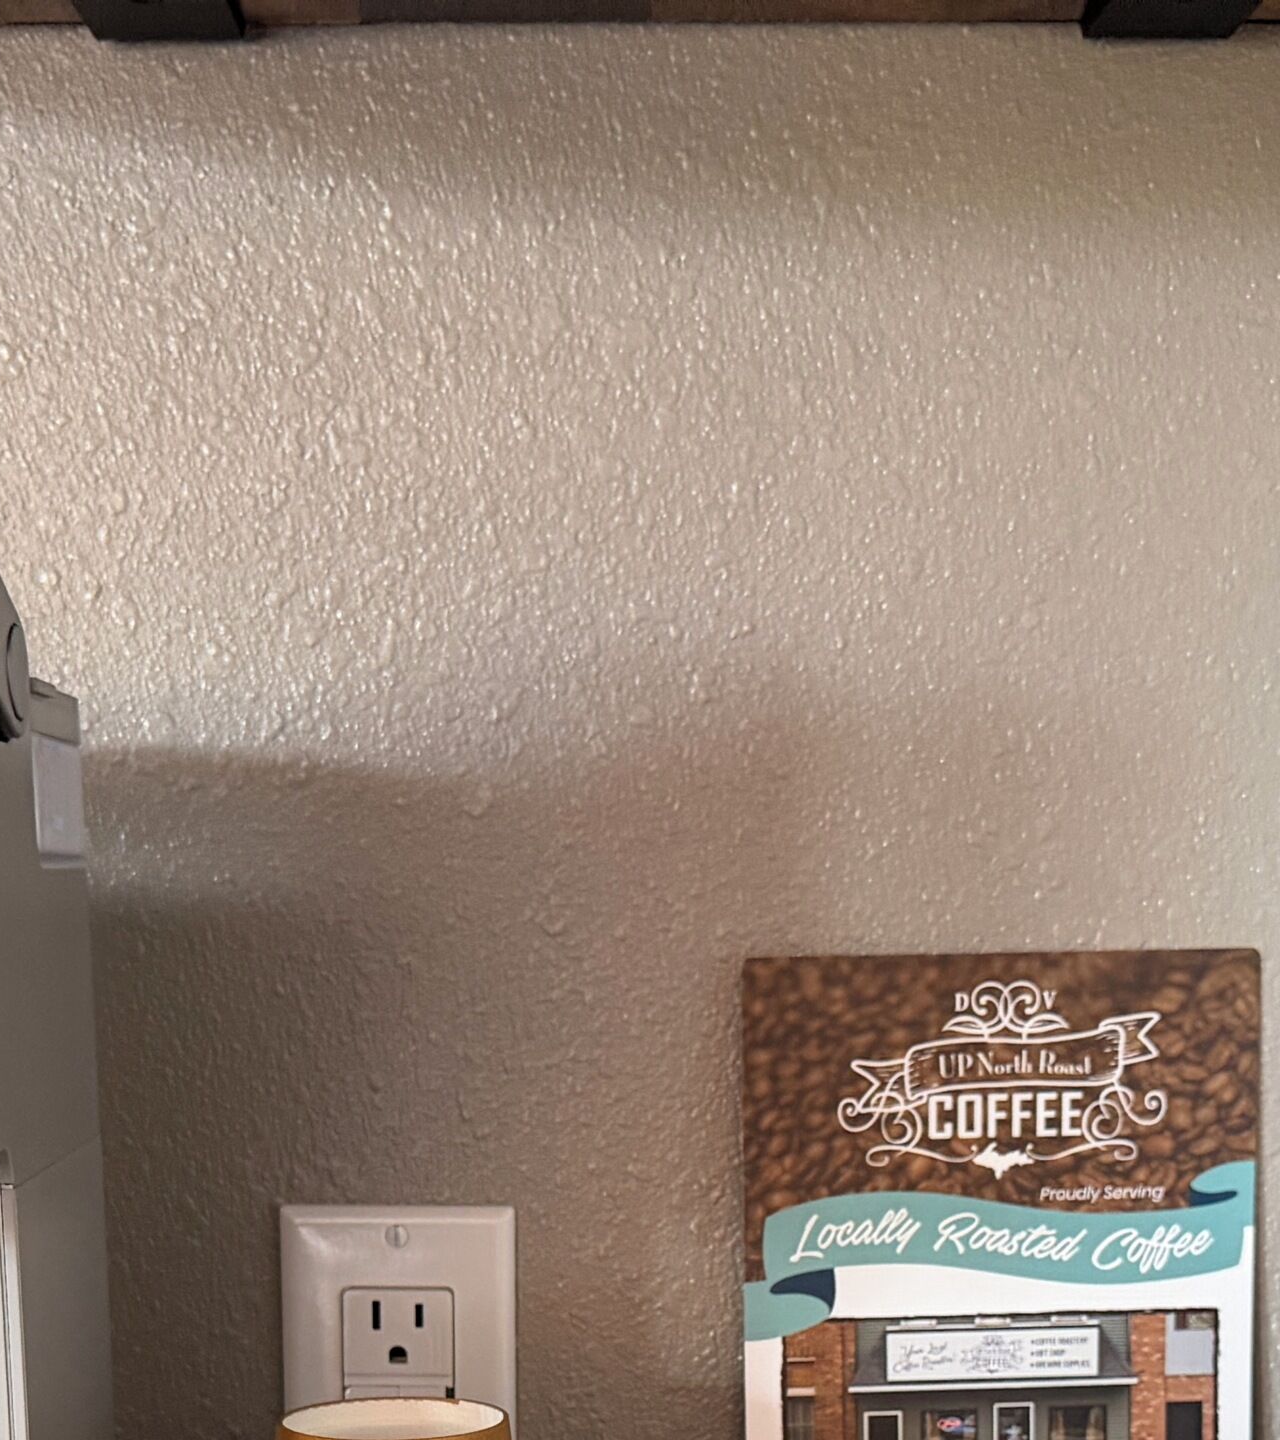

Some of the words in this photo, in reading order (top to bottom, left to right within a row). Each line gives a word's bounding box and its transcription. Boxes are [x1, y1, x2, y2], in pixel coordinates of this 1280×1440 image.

[954, 992, 970, 1013] D
[1042, 990, 1058, 1010] V
[938, 1053, 975, 1079] UP
[977, 1050, 1033, 1076] North
[1039, 1049, 1092, 1075] Roast
[927, 1091, 1084, 1140] COFFEE
[1040, 1186, 1100, 1203] Proudly
[1103, 1184, 1165, 1203] Serving
[789, 1207, 921, 1264] Locally
[933, 1211, 1088, 1261] Roasted
[1090, 1224, 1215, 1275] Coffee
